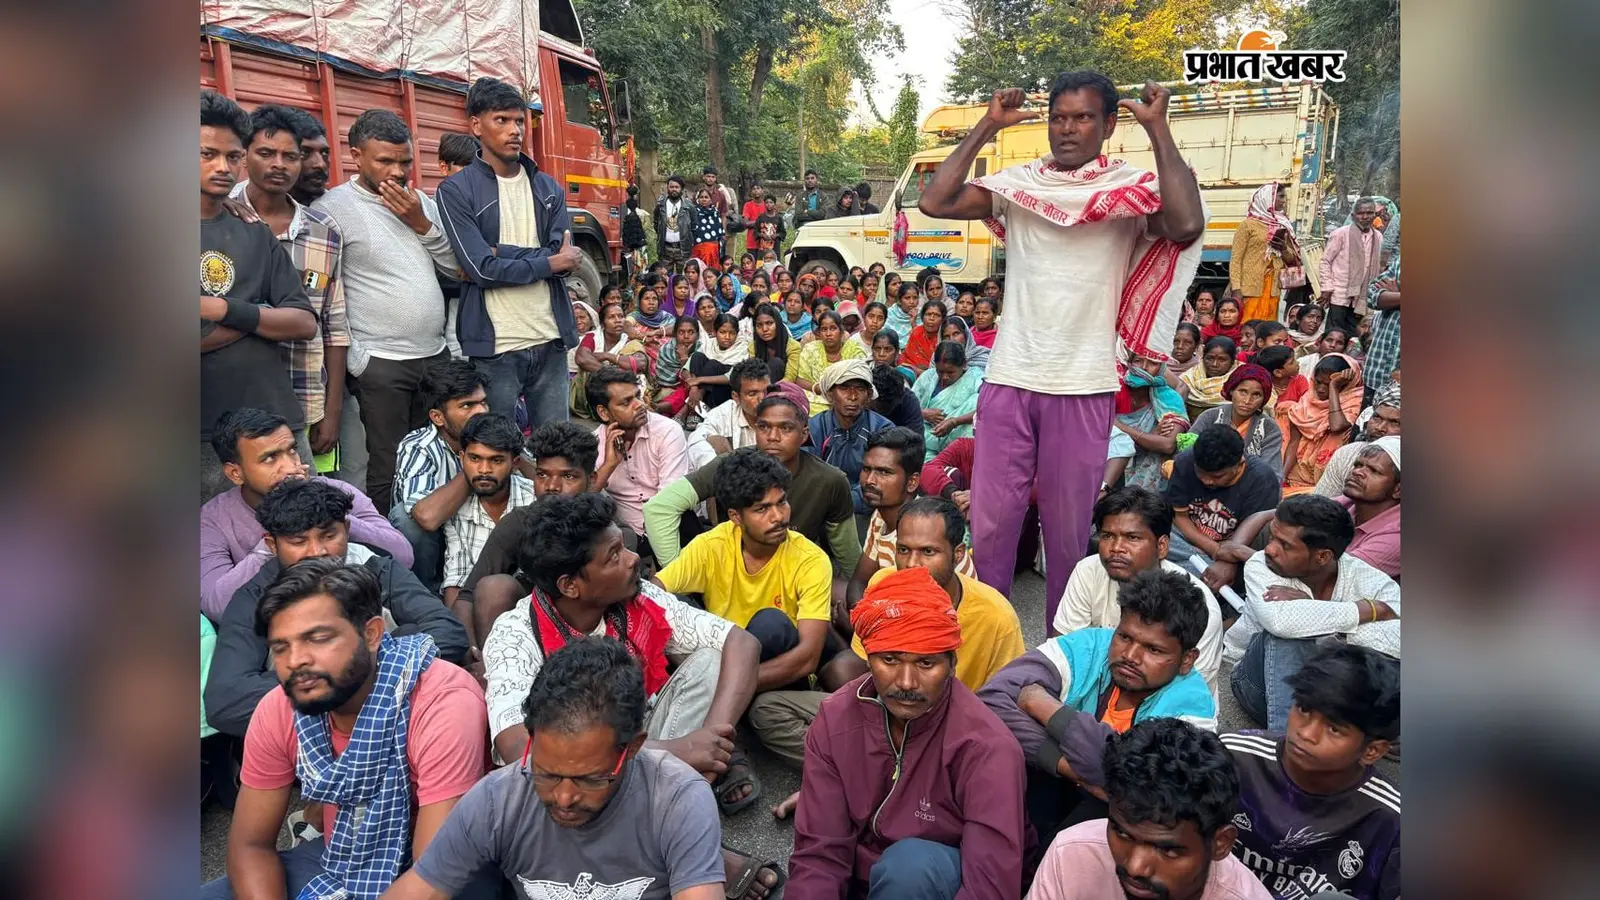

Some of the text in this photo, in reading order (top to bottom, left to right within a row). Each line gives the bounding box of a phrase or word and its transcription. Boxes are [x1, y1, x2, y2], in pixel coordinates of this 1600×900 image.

[1042, 202, 1070, 224] जोहार
[914, 810, 935, 821] aidas
[1232, 838, 1352, 893] mirate
